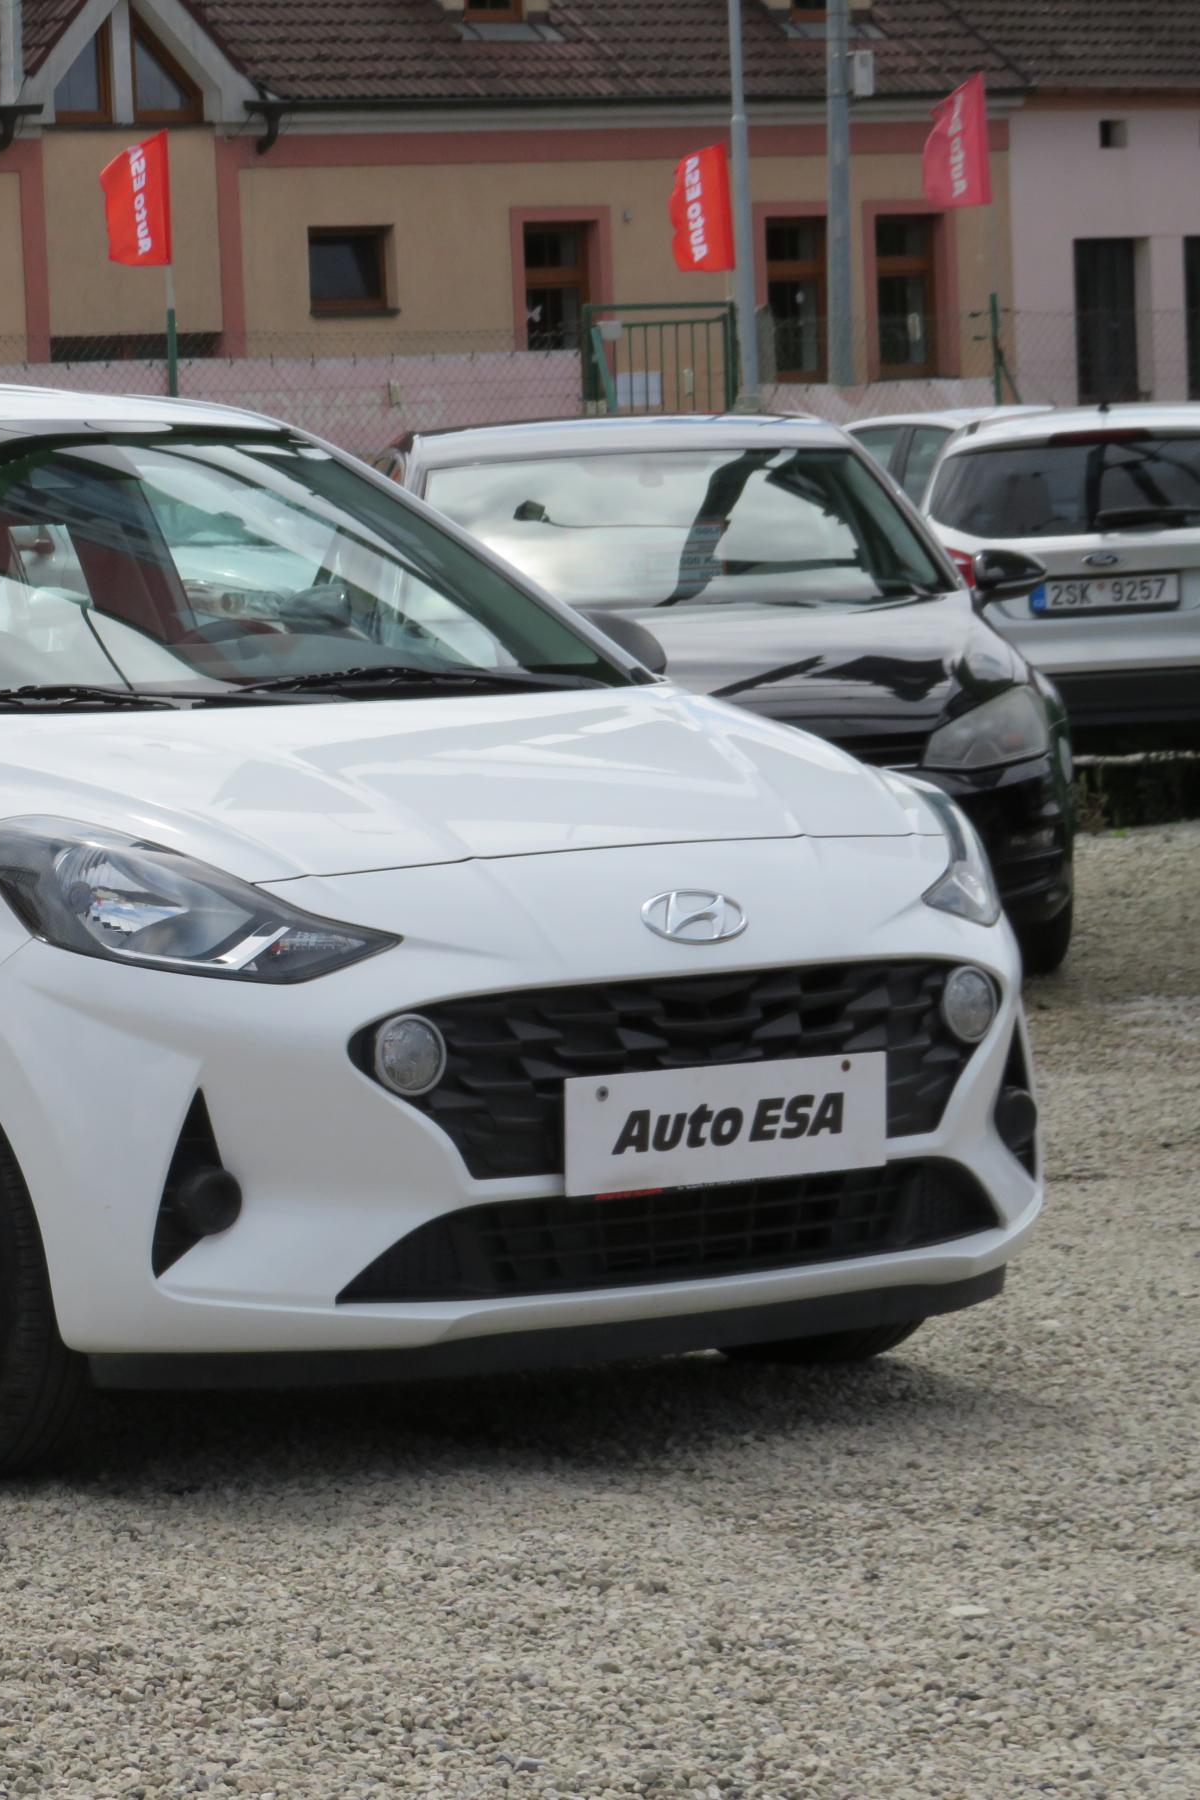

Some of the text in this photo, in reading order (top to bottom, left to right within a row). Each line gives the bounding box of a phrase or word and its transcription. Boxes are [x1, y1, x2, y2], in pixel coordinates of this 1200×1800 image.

[1051, 583, 1091, 606] 2SK
[1111, 578, 1167, 602] 9257
[611, 1091, 845, 1155] Auto ESA
